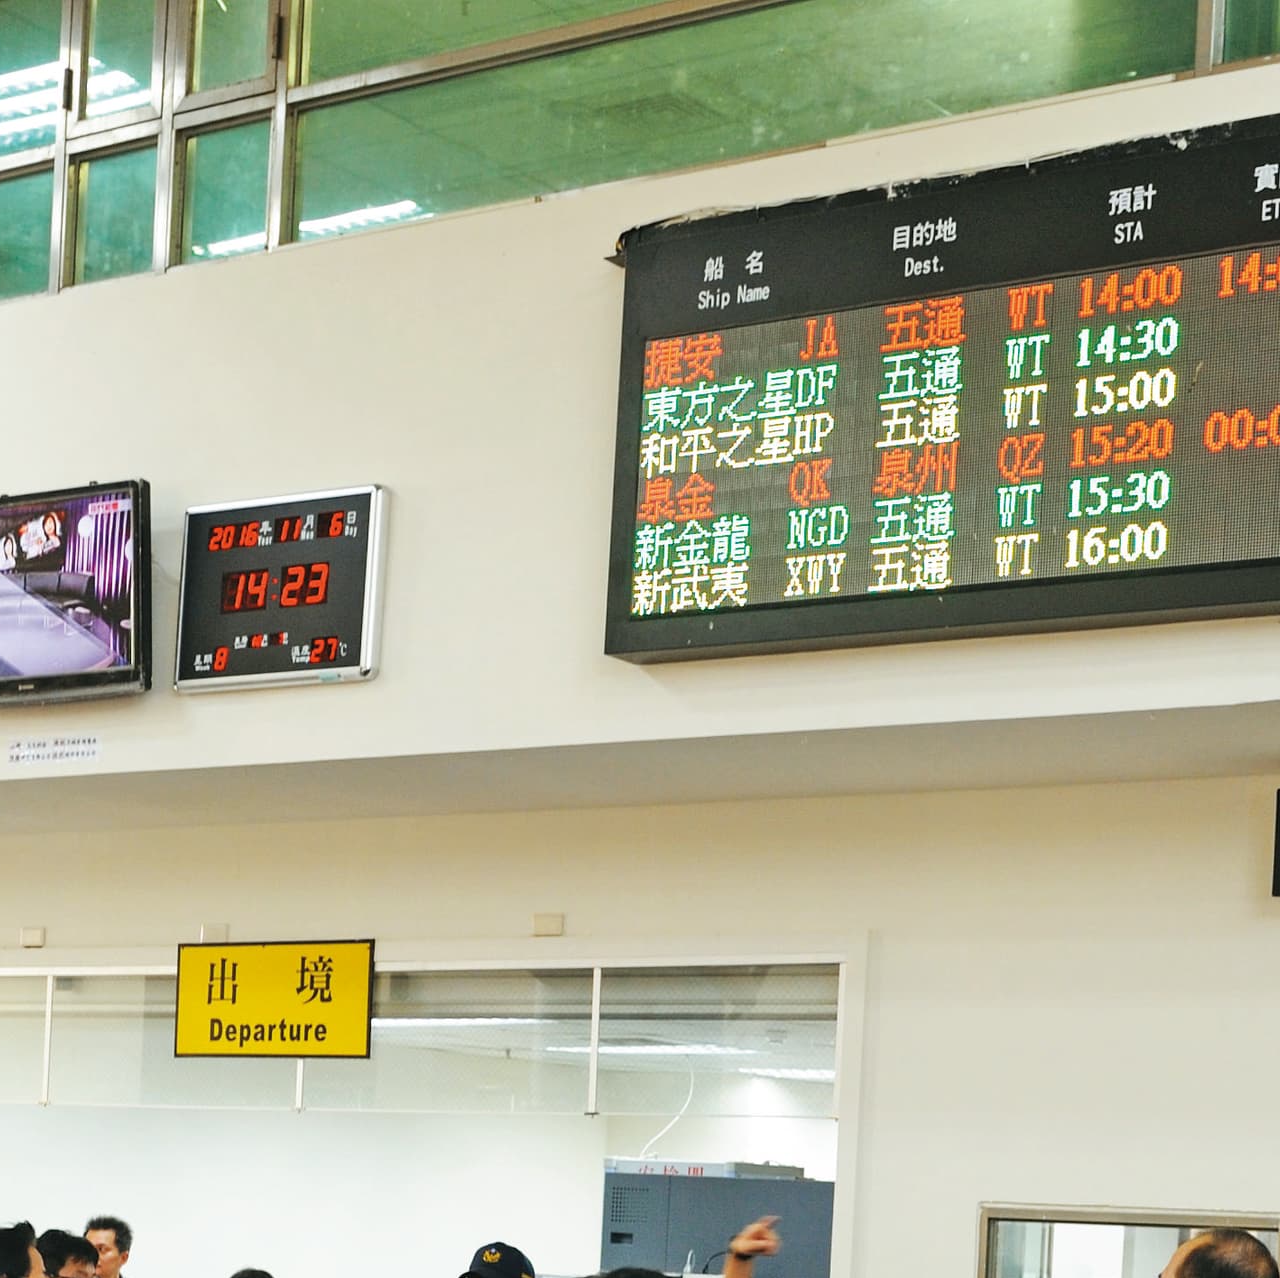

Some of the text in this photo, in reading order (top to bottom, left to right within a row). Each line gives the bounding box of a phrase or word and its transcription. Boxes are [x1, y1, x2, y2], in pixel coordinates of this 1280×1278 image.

[1108, 183, 1157, 216] 預計
[892, 217, 958, 252] 目的地
[1114, 221, 1144, 244] STA
[704, 250, 764, 282] 船名
[904, 256, 945, 278] Dest.
[697, 284, 770, 310] Ship Name
[644, 334, 723, 388] 捷安
[800, 316, 839, 351] JA
[880, 296, 967, 352] 五通
[1008, 283, 1053, 330] WT
[1078, 265, 1182, 318] 14:00
[878, 346, 963, 400] 五通
[1005, 334, 1050, 380] WT
[1076, 317, 1179, 367] 14:30
[876, 395, 961, 448] 五通
[1003, 384, 1048, 429] WT
[1074, 368, 1176, 418] 15:00
[637, 473, 716, 524] 泉金
[788, 457, 833, 507] QK
[872, 441, 959, 498] 泉州
[997, 433, 1044, 483] QZ
[1070, 418, 1174, 469] 15:20
[208, 521, 260, 552] 2016
[280, 518, 303, 542] 11
[329, 512, 345, 537] 6
[346, 511, 357, 524] 日
[634, 514, 751, 570] 新金龍
[786, 505, 849, 550] NGD
[869, 492, 955, 545] 五通
[997, 484, 1042, 528] WT
[1068, 471, 1170, 518] 15:30
[233, 562, 330, 611] 14:23
[631, 562, 749, 616] 新武夷
[784, 553, 846, 597] XWY
[867, 541, 952, 593] 五通
[995, 533, 1039, 577] WT
[1065, 521, 1169, 570] 16:00
[213, 645, 230, 672] 8
[310, 636, 339, 664] 27
[207, 955, 334, 1006] 出境
[209, 1018, 328, 1048] Departure
